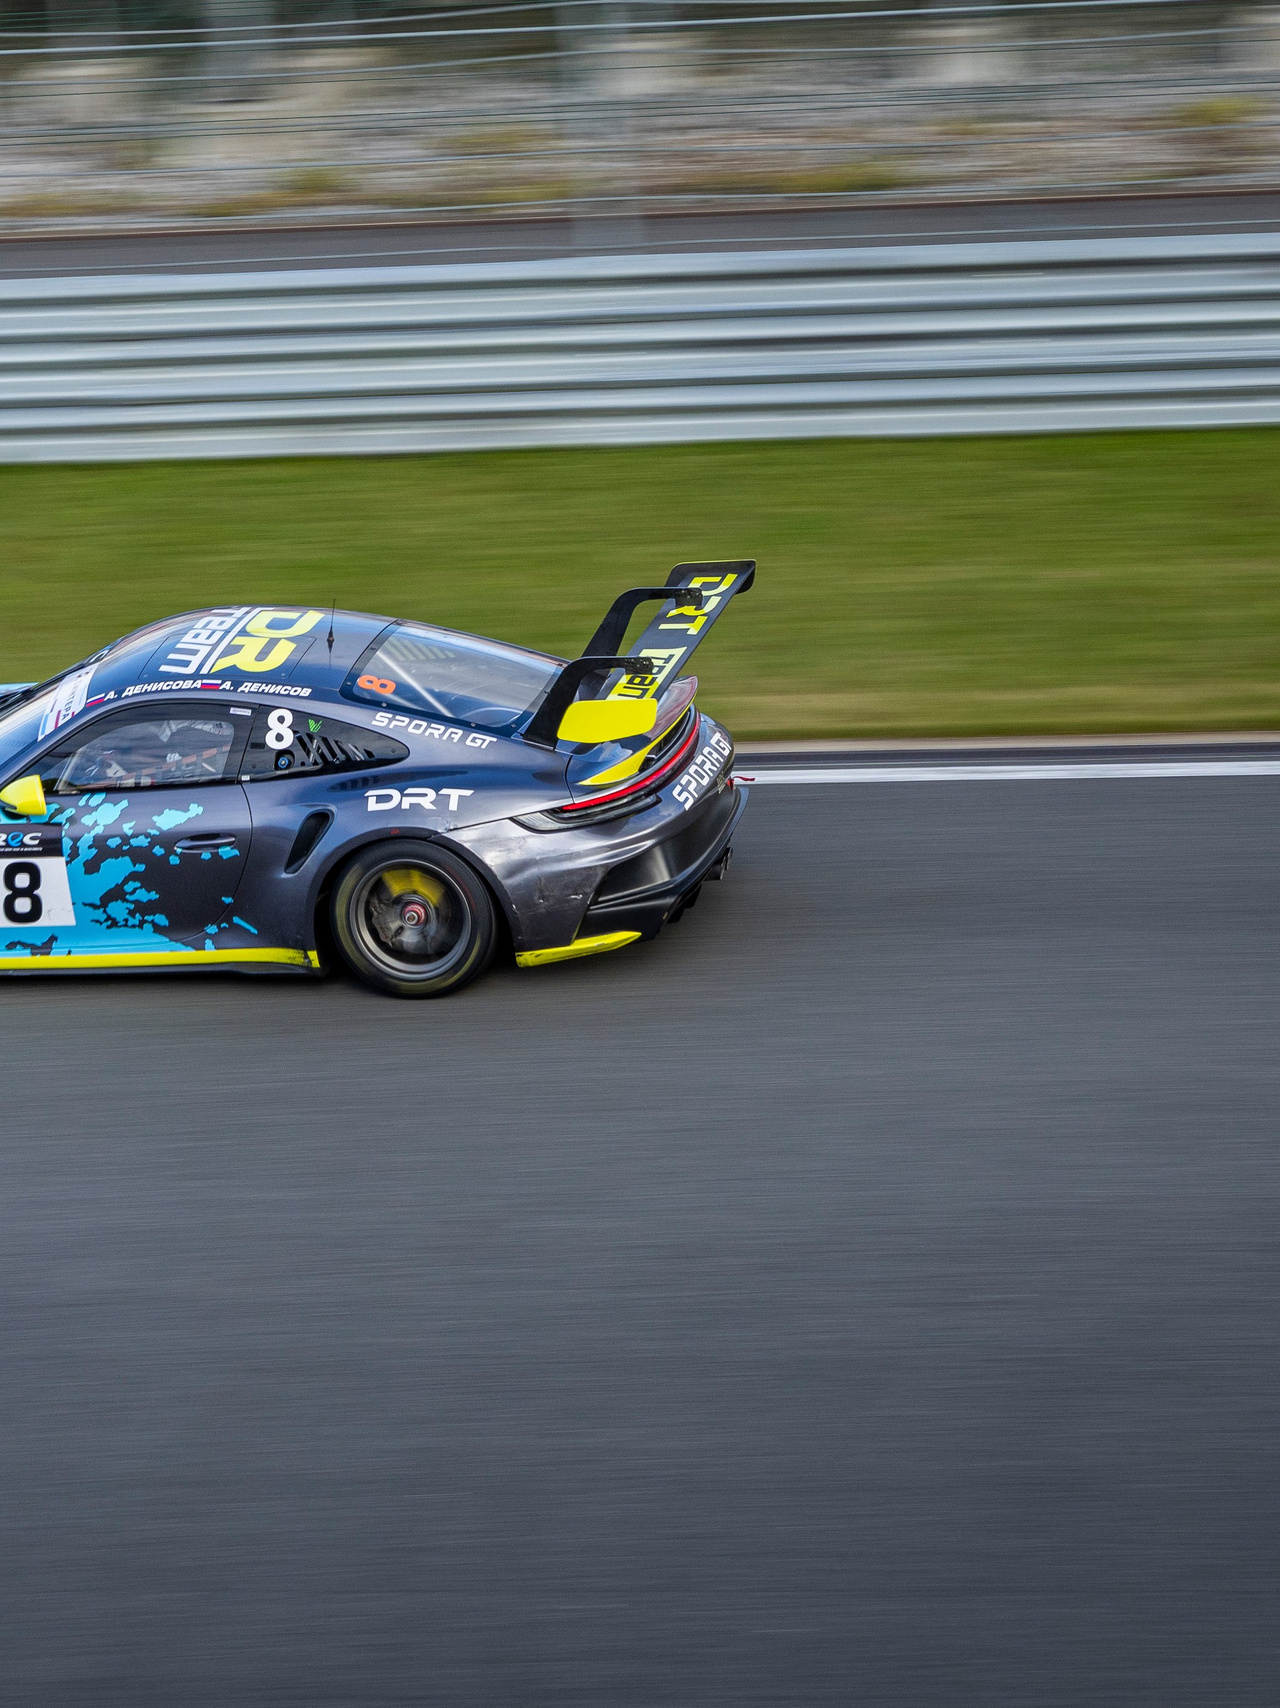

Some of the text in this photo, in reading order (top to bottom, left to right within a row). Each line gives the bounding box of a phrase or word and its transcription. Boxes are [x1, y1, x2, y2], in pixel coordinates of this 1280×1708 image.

[658, 573, 738, 636] DRT
[210, 610, 325, 674] DR
[103, 679, 202, 702] А. ДЕНИСОВА
[219, 680, 312, 697] А. ДЕНИСОВ
[357, 674, 396, 695] 8
[265, 708, 294, 750] 8
[371, 711, 497, 749] SPORA GT
[672, 746, 724, 811] SPORA
[364, 787, 475, 812] DRT
[3, 861, 43, 923] 8
